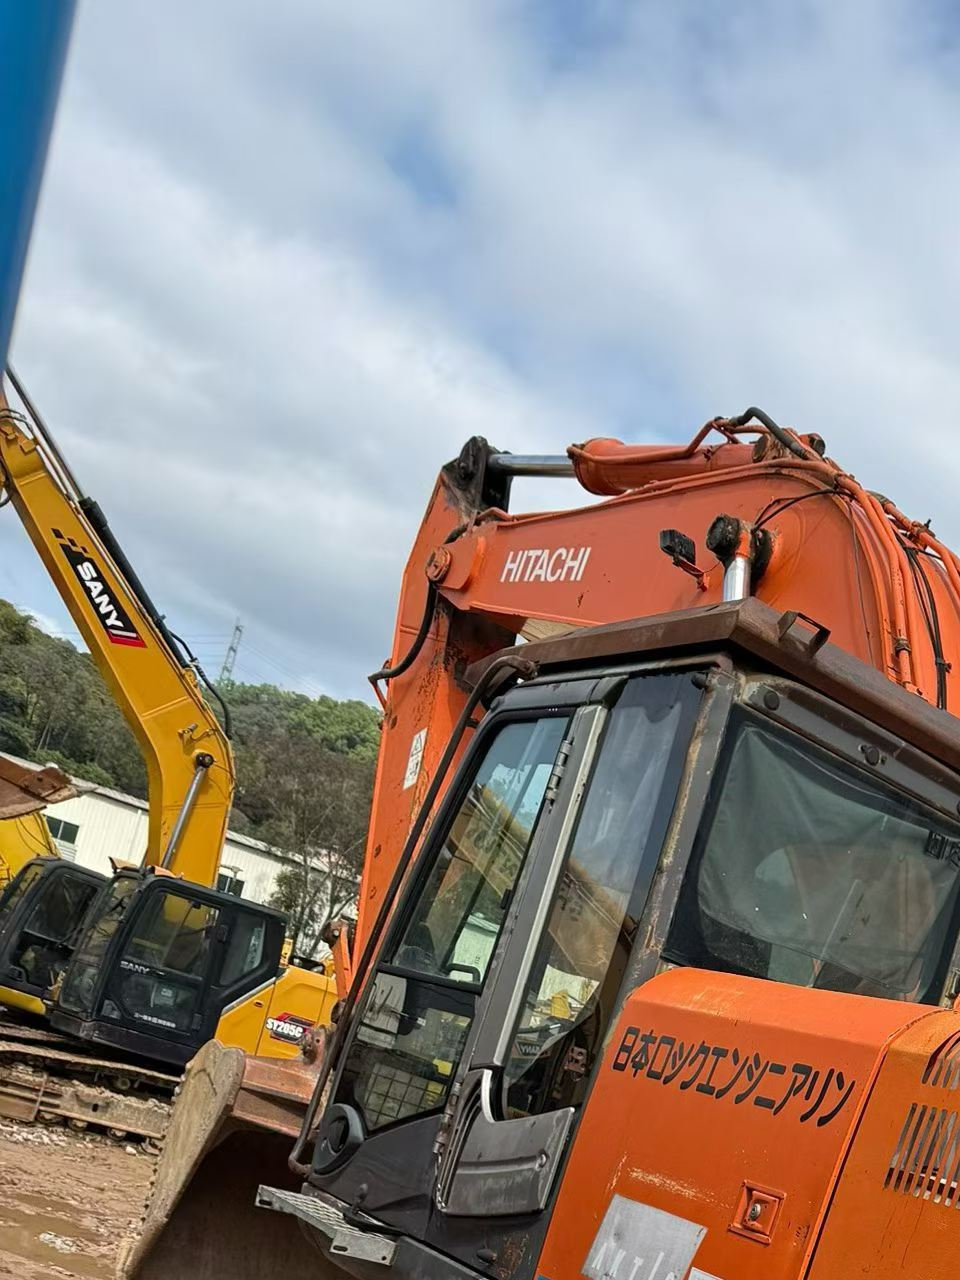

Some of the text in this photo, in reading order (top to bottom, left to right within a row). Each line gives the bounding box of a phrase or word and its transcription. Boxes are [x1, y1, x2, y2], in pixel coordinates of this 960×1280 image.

[500, 547, 592, 582] HITACHI
[76, 561, 125, 628] SANY
[266, 1017, 304, 1038] SY205C
